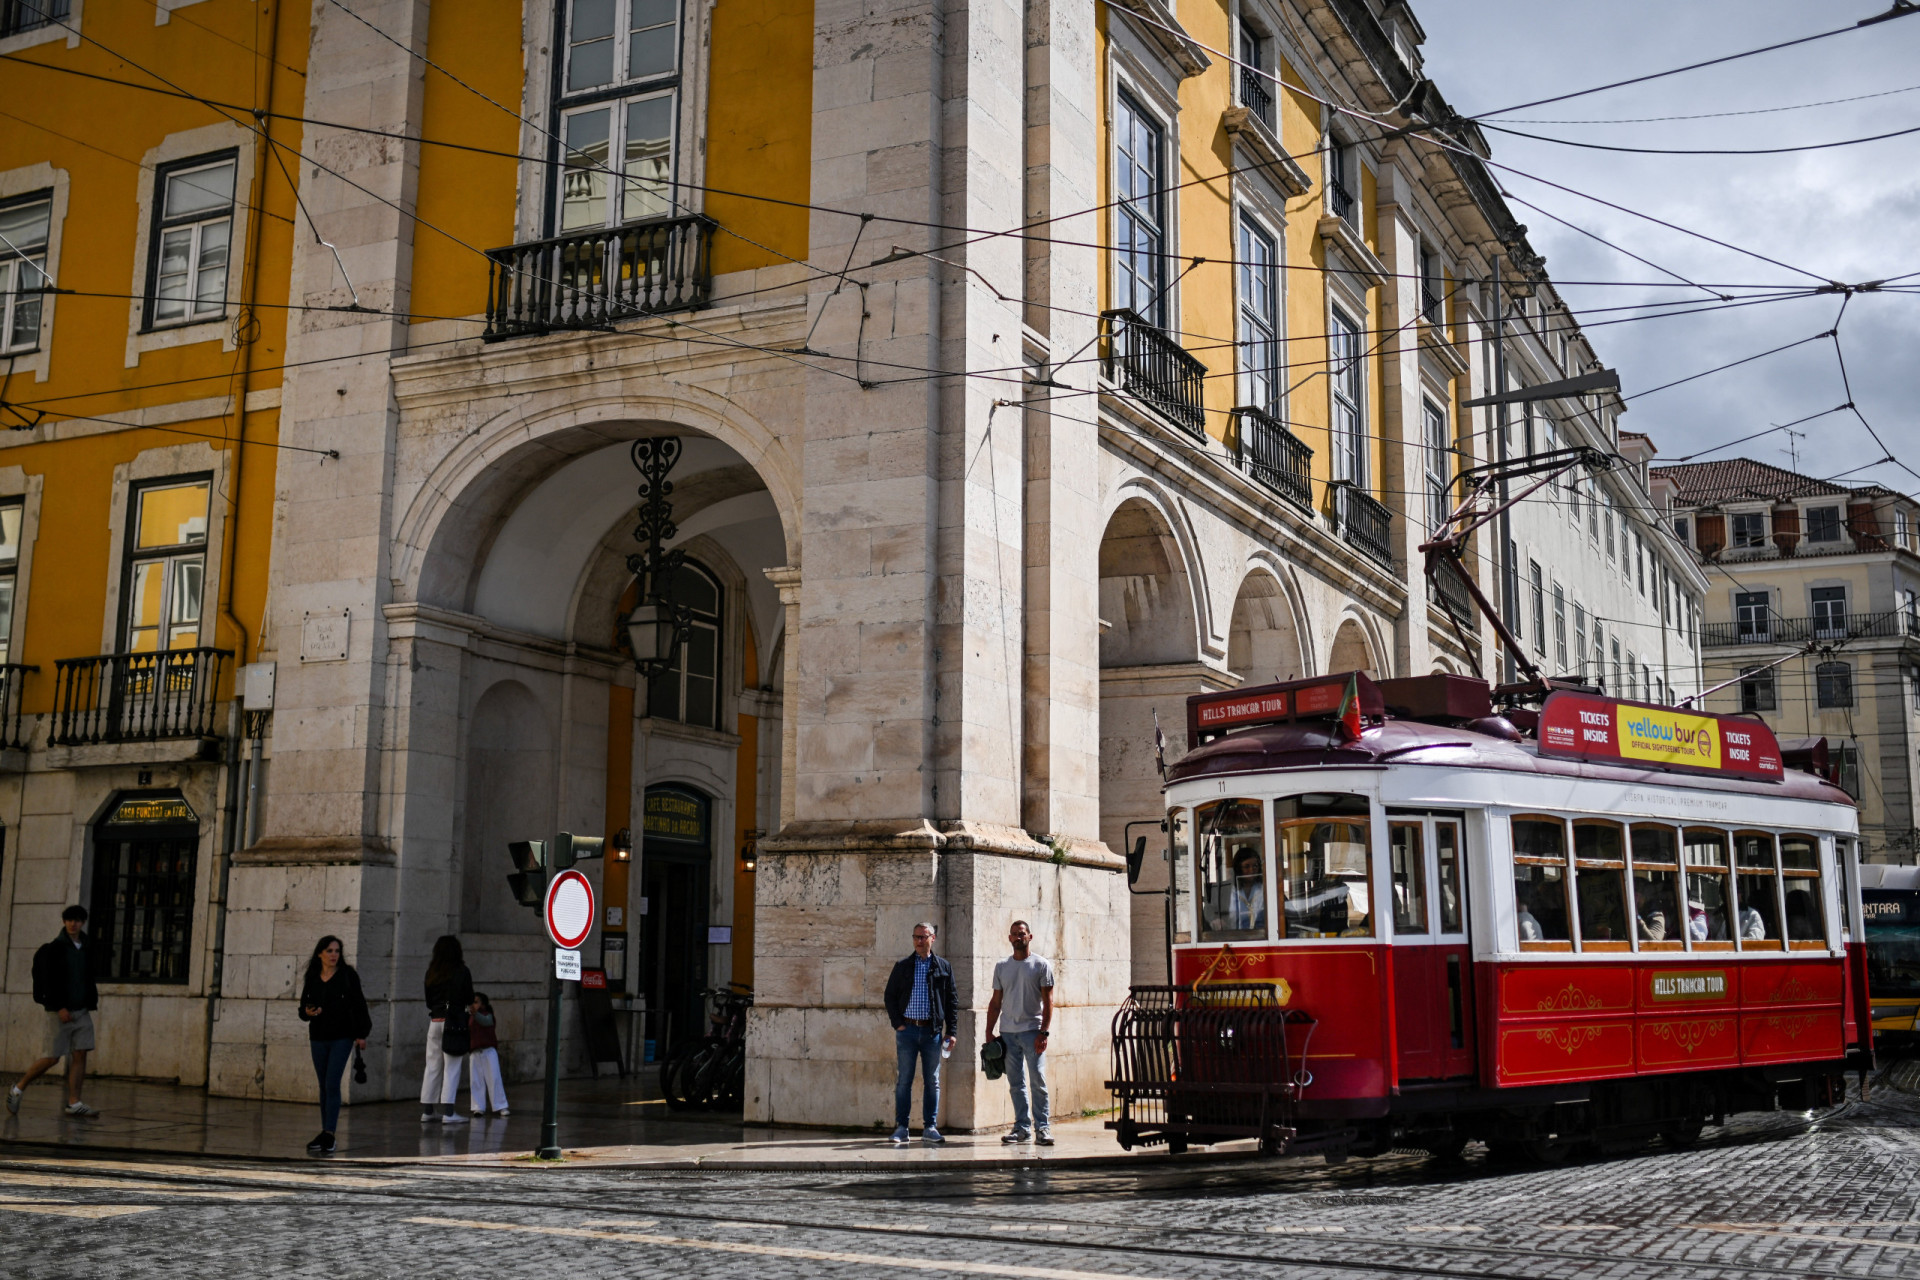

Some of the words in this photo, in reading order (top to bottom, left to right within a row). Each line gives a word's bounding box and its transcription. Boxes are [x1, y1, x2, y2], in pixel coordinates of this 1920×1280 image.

[1203, 706, 1226, 721] HILLS
[1262, 698, 1282, 713] TOUR
[1579, 711, 1610, 727] TICKETS
[1583, 729, 1609, 744] INSIDE
[1674, 721, 1696, 744] bus
[1725, 731, 1751, 746] TICKETS
[1631, 740, 1652, 751] OFFICIAL
[1652, 743, 1681, 755] SIGHTSEEING
[1681, 746, 1696, 756] TOURS
[1729, 747, 1750, 762] INSIDE
[1218, 780, 1226, 793] 11
[1680, 797, 1703, 809] PREMIUM
[120, 806, 135, 819] CASA
[136, 805, 163, 819] FUNDADA
[1654, 977, 1676, 995] HILLS
[1706, 975, 1725, 993] TOUR
